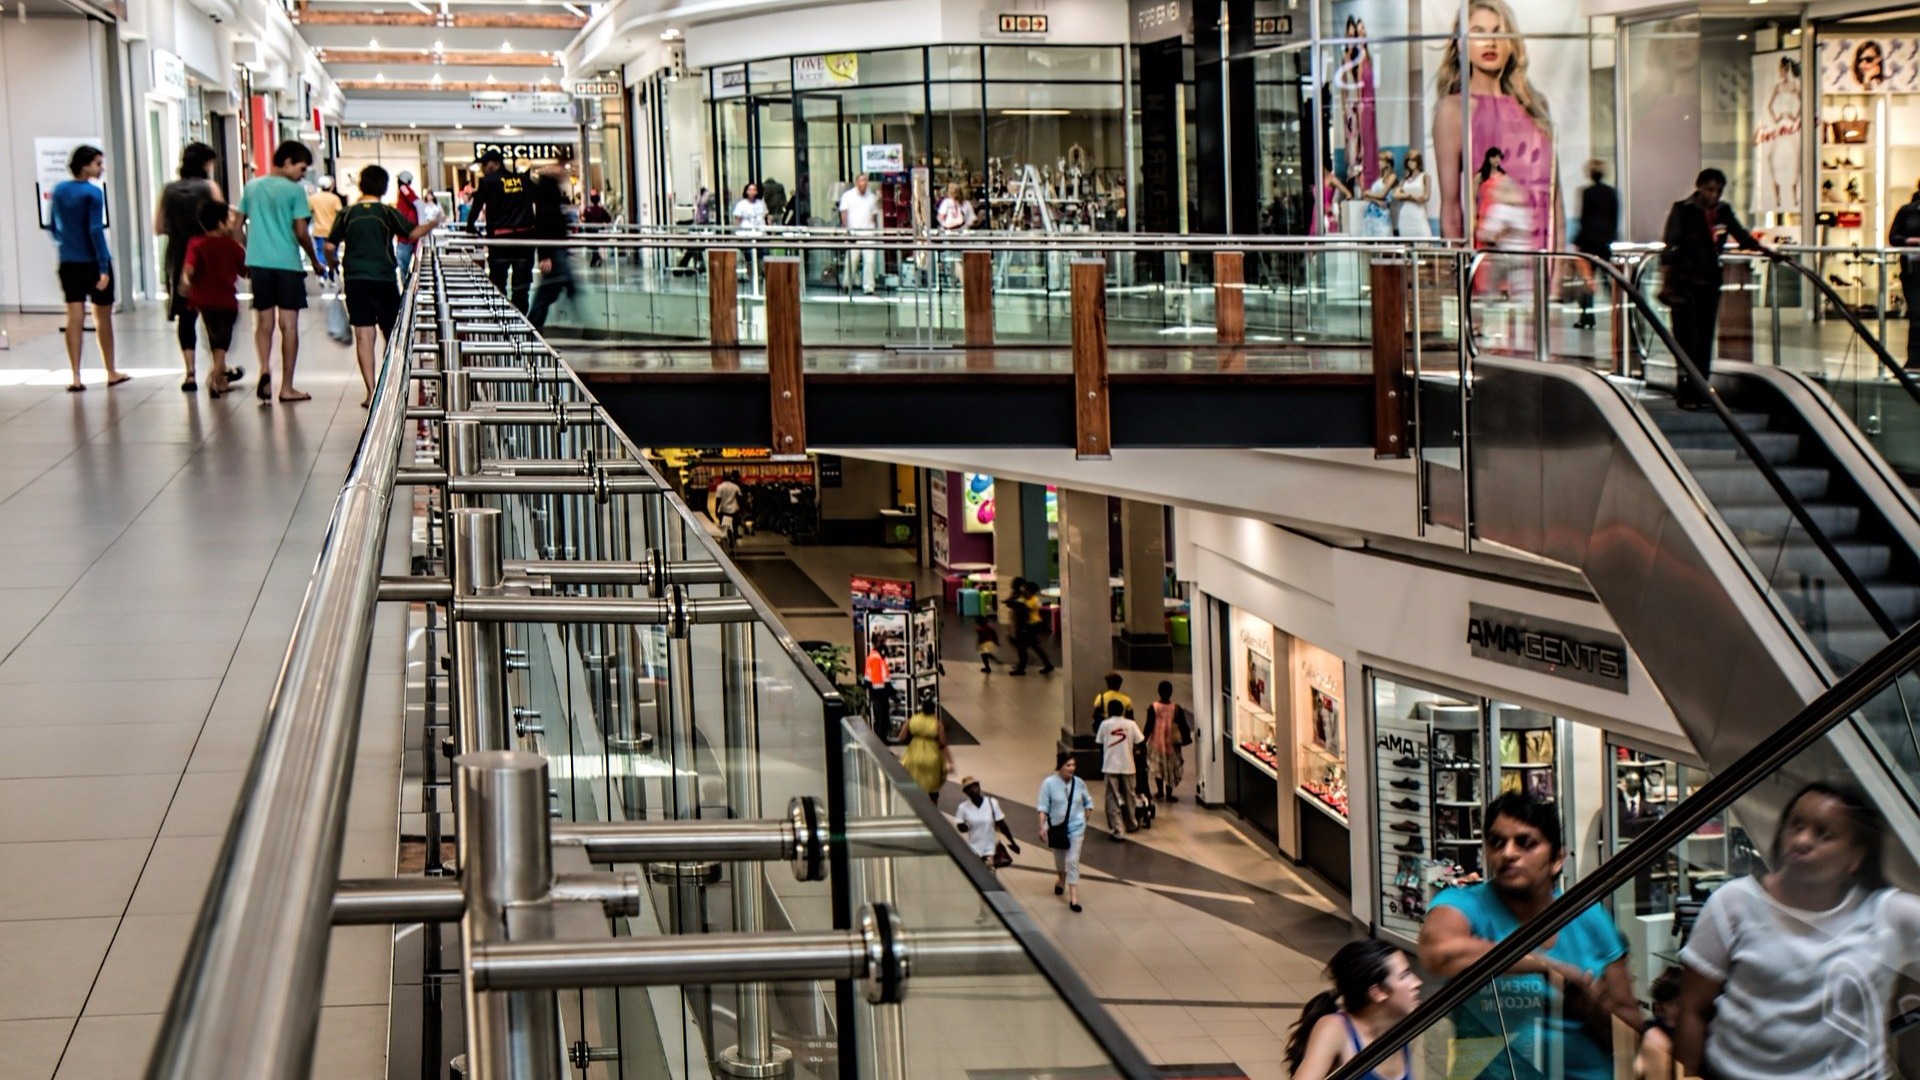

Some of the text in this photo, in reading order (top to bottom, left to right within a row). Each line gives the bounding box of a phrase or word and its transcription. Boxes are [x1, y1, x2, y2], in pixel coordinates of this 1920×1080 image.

[795, 56, 824, 71] LOVE
[1467, 618, 1620, 679] AMA GENTS
[1377, 733, 1415, 758] AMA
